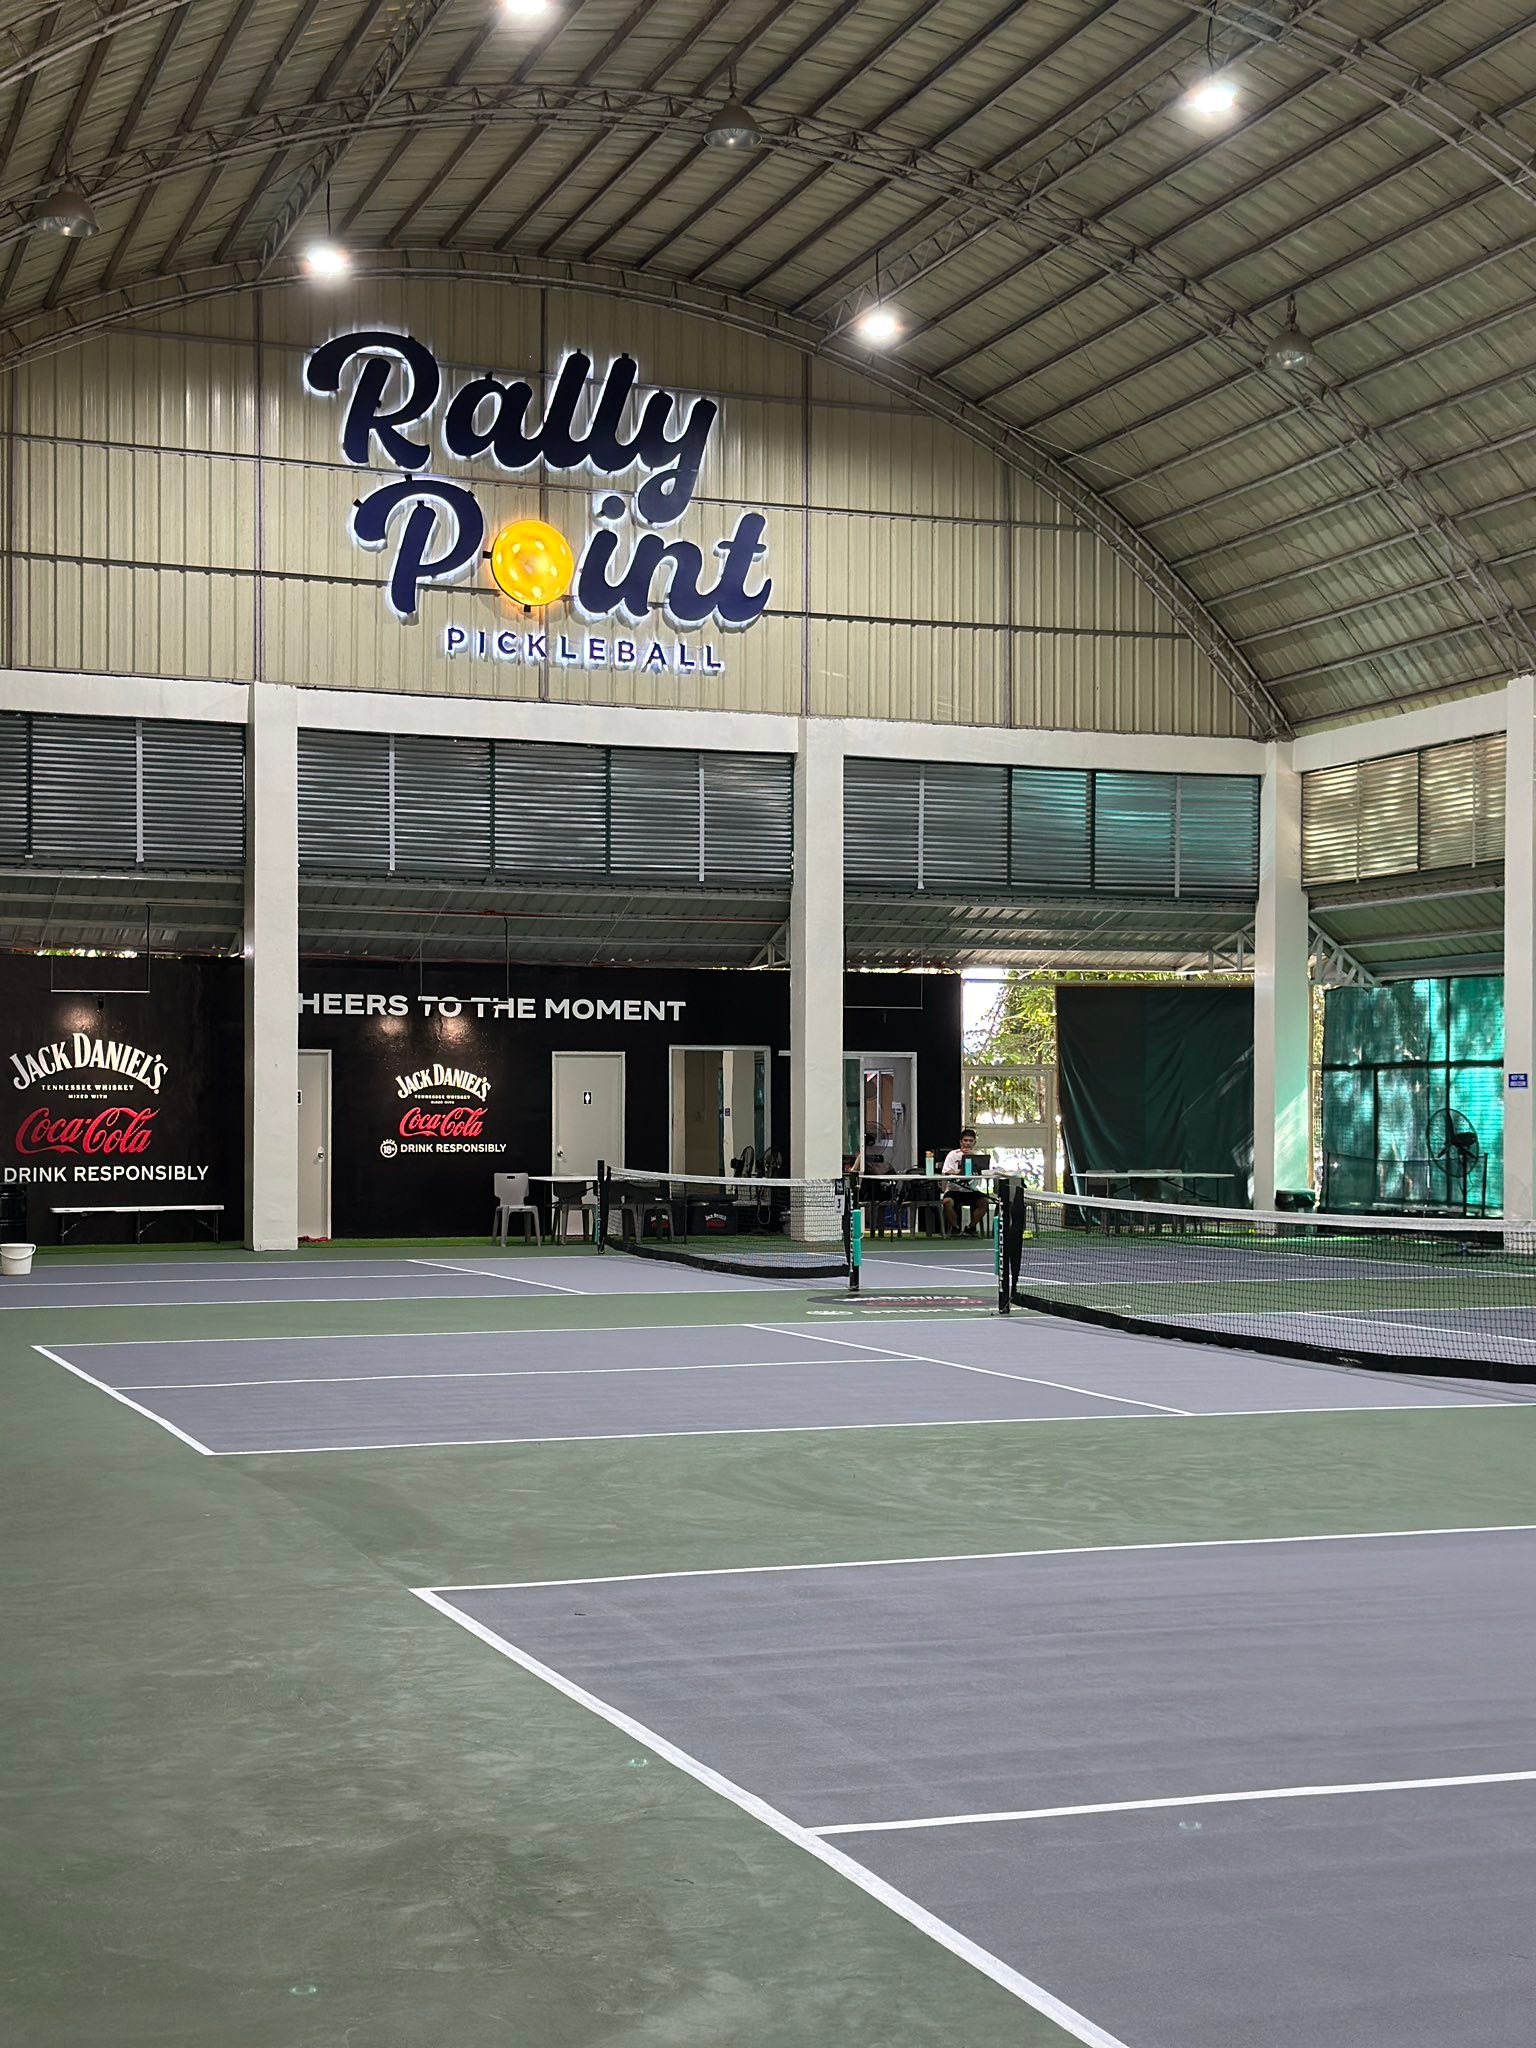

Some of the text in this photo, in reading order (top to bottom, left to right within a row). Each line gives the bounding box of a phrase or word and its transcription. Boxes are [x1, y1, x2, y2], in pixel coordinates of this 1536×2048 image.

[307, 331, 718, 524] Rally
[446, 627, 724, 671] PICKLEBALL
[298, 992, 687, 1021] HEERS TO THE MOMENT
[9, 1032, 169, 1095] JACK DANIEL'S
[395, 1063, 492, 1102] JACK DANIEL'S
[15, 1107, 161, 1154] Coca-Cola
[399, 1106, 488, 1137] Coca-Cola
[400, 1143, 507, 1153] DRINK RESPONSIBLY
[3, 1165, 209, 1183] DRINK RESPONSIBLY
